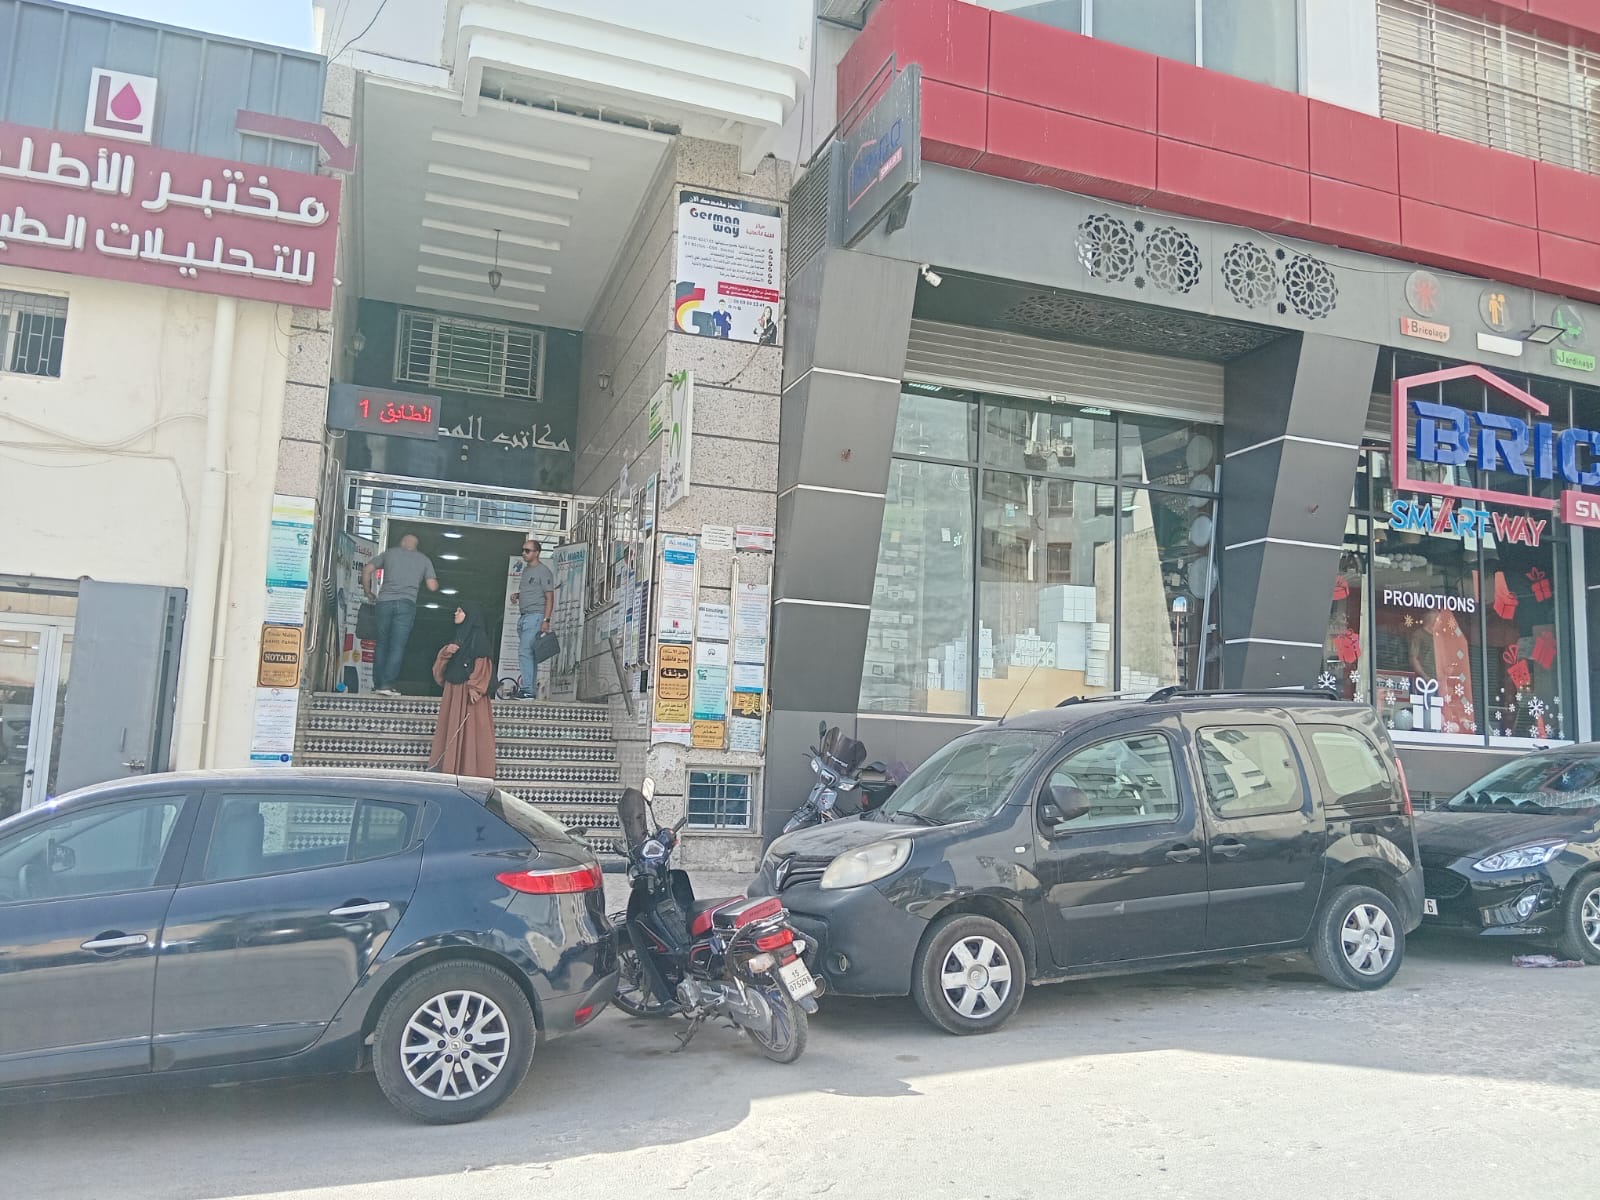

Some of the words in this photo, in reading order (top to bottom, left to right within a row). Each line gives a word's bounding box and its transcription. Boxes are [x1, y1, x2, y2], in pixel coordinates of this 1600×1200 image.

[0, 136, 135, 197] الأطل
[141, 169, 329, 227] مختبر
[690, 207, 740, 225] German
[0, 206, 86, 252] الطب
[713, 223, 740, 238] way
[96, 222, 315, 286] للتحليلات
[1411, 320, 1448, 339] Bricolage
[359, 399, 369, 418] 1
[380, 402, 431, 423] الطابق
[492, 423, 570, 452] مكاتب
[1384, 589, 1476, 613] PROMOTIONS
[264, 652, 298, 663] NOTAIRE
[661, 668, 688, 679] موثقة
[1427, 900, 1434, 913] 6
[791, 969, 800, 978] 15
